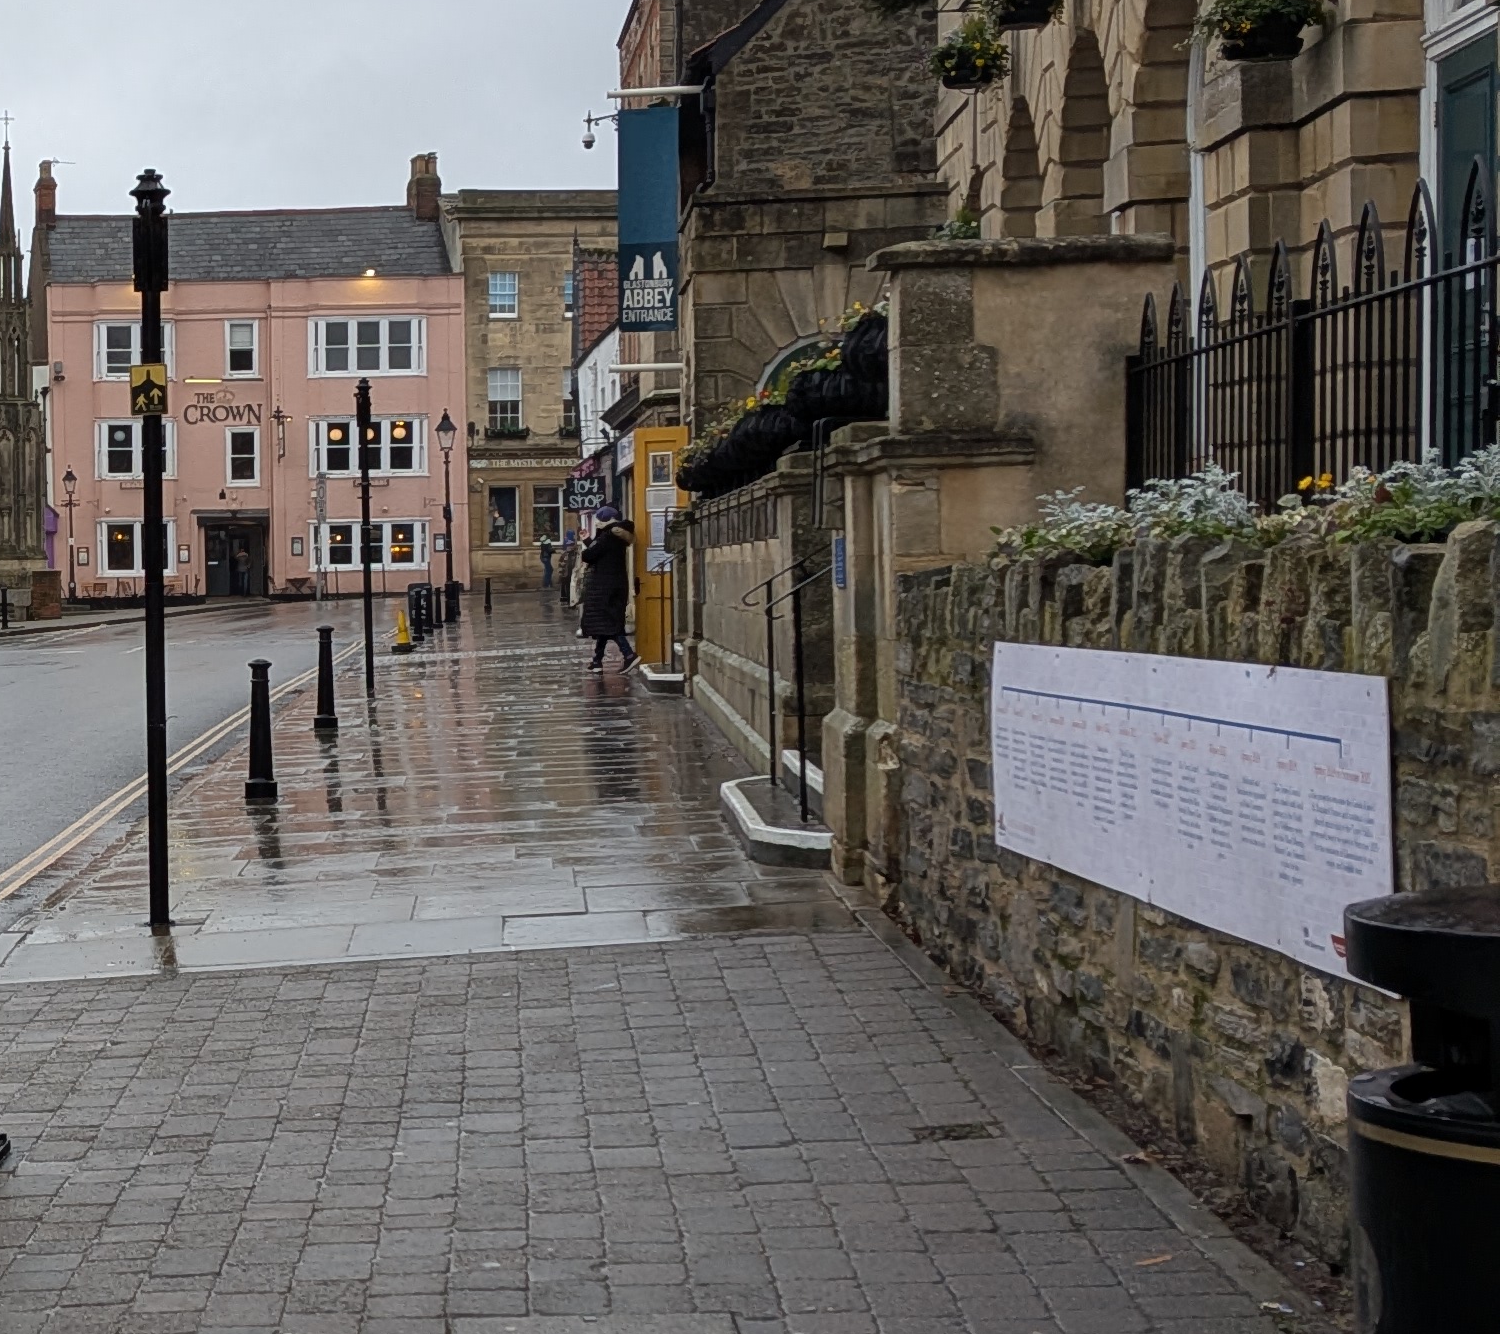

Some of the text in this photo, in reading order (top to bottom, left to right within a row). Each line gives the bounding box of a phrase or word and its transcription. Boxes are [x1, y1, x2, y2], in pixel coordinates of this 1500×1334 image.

[623, 278, 674, 289] GLASTONBURY
[622, 287, 674, 308] ABBEY
[622, 308, 674, 323] ENTRANCE
[194, 392, 215, 404] THE
[183, 403, 263, 425] CROWN
[492, 459, 507, 467] THE
[509, 458, 539, 467] MYSTIC
